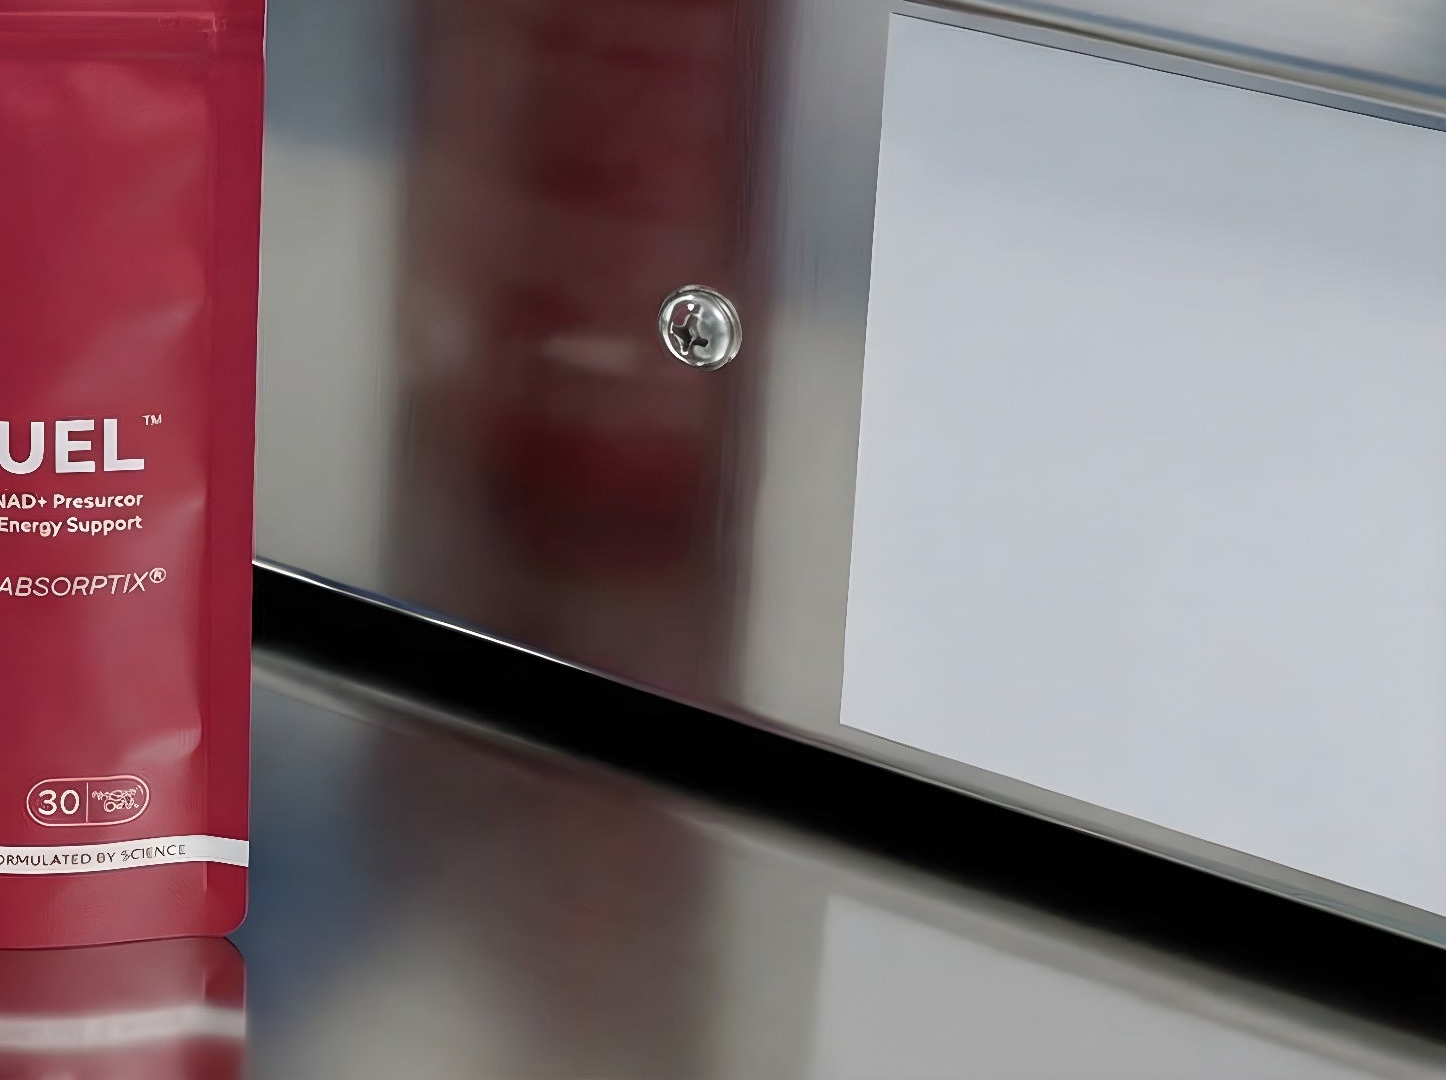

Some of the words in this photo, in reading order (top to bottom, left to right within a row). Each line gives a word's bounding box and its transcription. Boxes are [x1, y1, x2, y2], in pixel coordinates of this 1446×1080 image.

[54, 493, 143, 509] Presurcor
[67, 515, 143, 536] Support
[38, 789, 80, 815] 30
